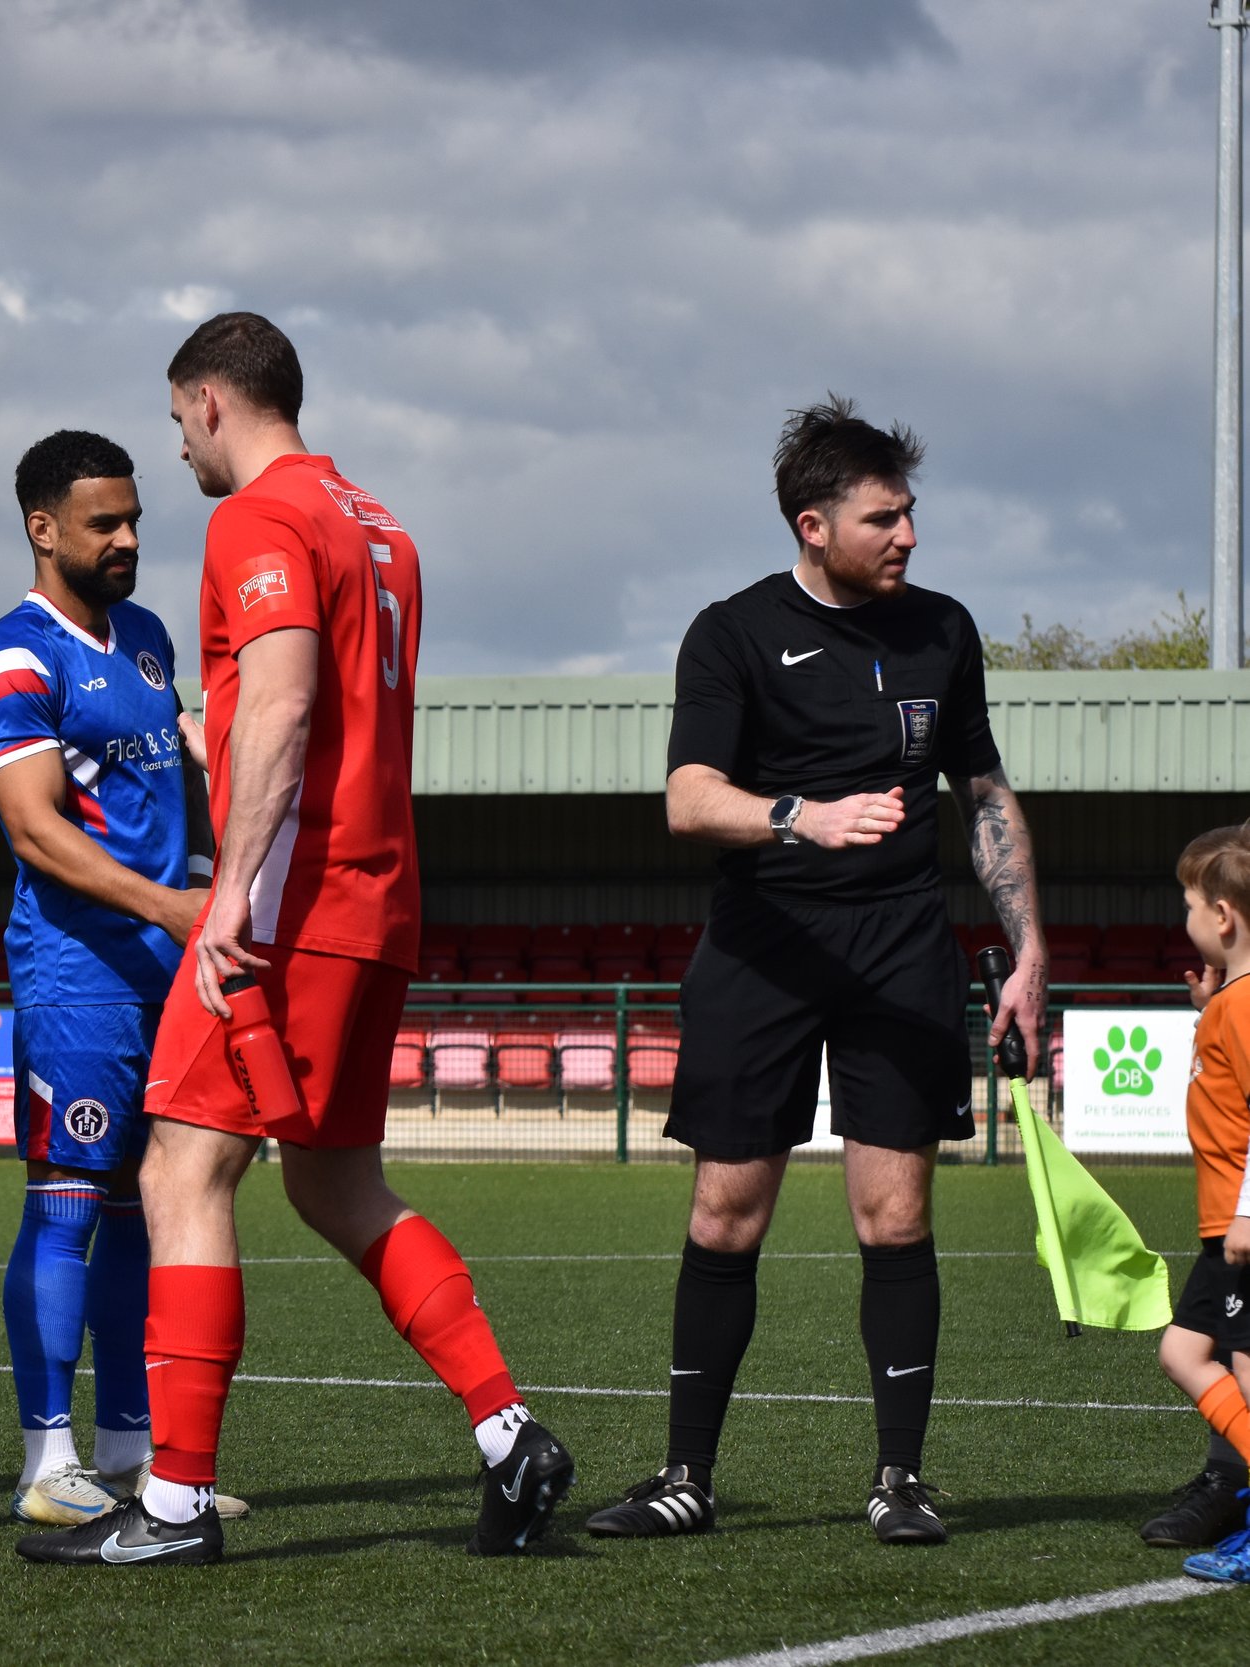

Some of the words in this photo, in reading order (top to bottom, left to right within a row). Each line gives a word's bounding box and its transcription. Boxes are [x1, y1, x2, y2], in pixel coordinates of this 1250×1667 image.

[243, 573, 278, 597] PITCHING
[259, 584, 268, 597] IN
[367, 541, 400, 689] 5
[79, 677, 107, 692] VX3
[105, 734, 144, 763] Flick
[145, 732, 161, 755] &
[141, 760, 162, 772] Coast
[234, 1047, 261, 1116] FORZA
[1114, 1068, 1143, 1089] DB
[78, 1100, 103, 1111] FOOTBALL
